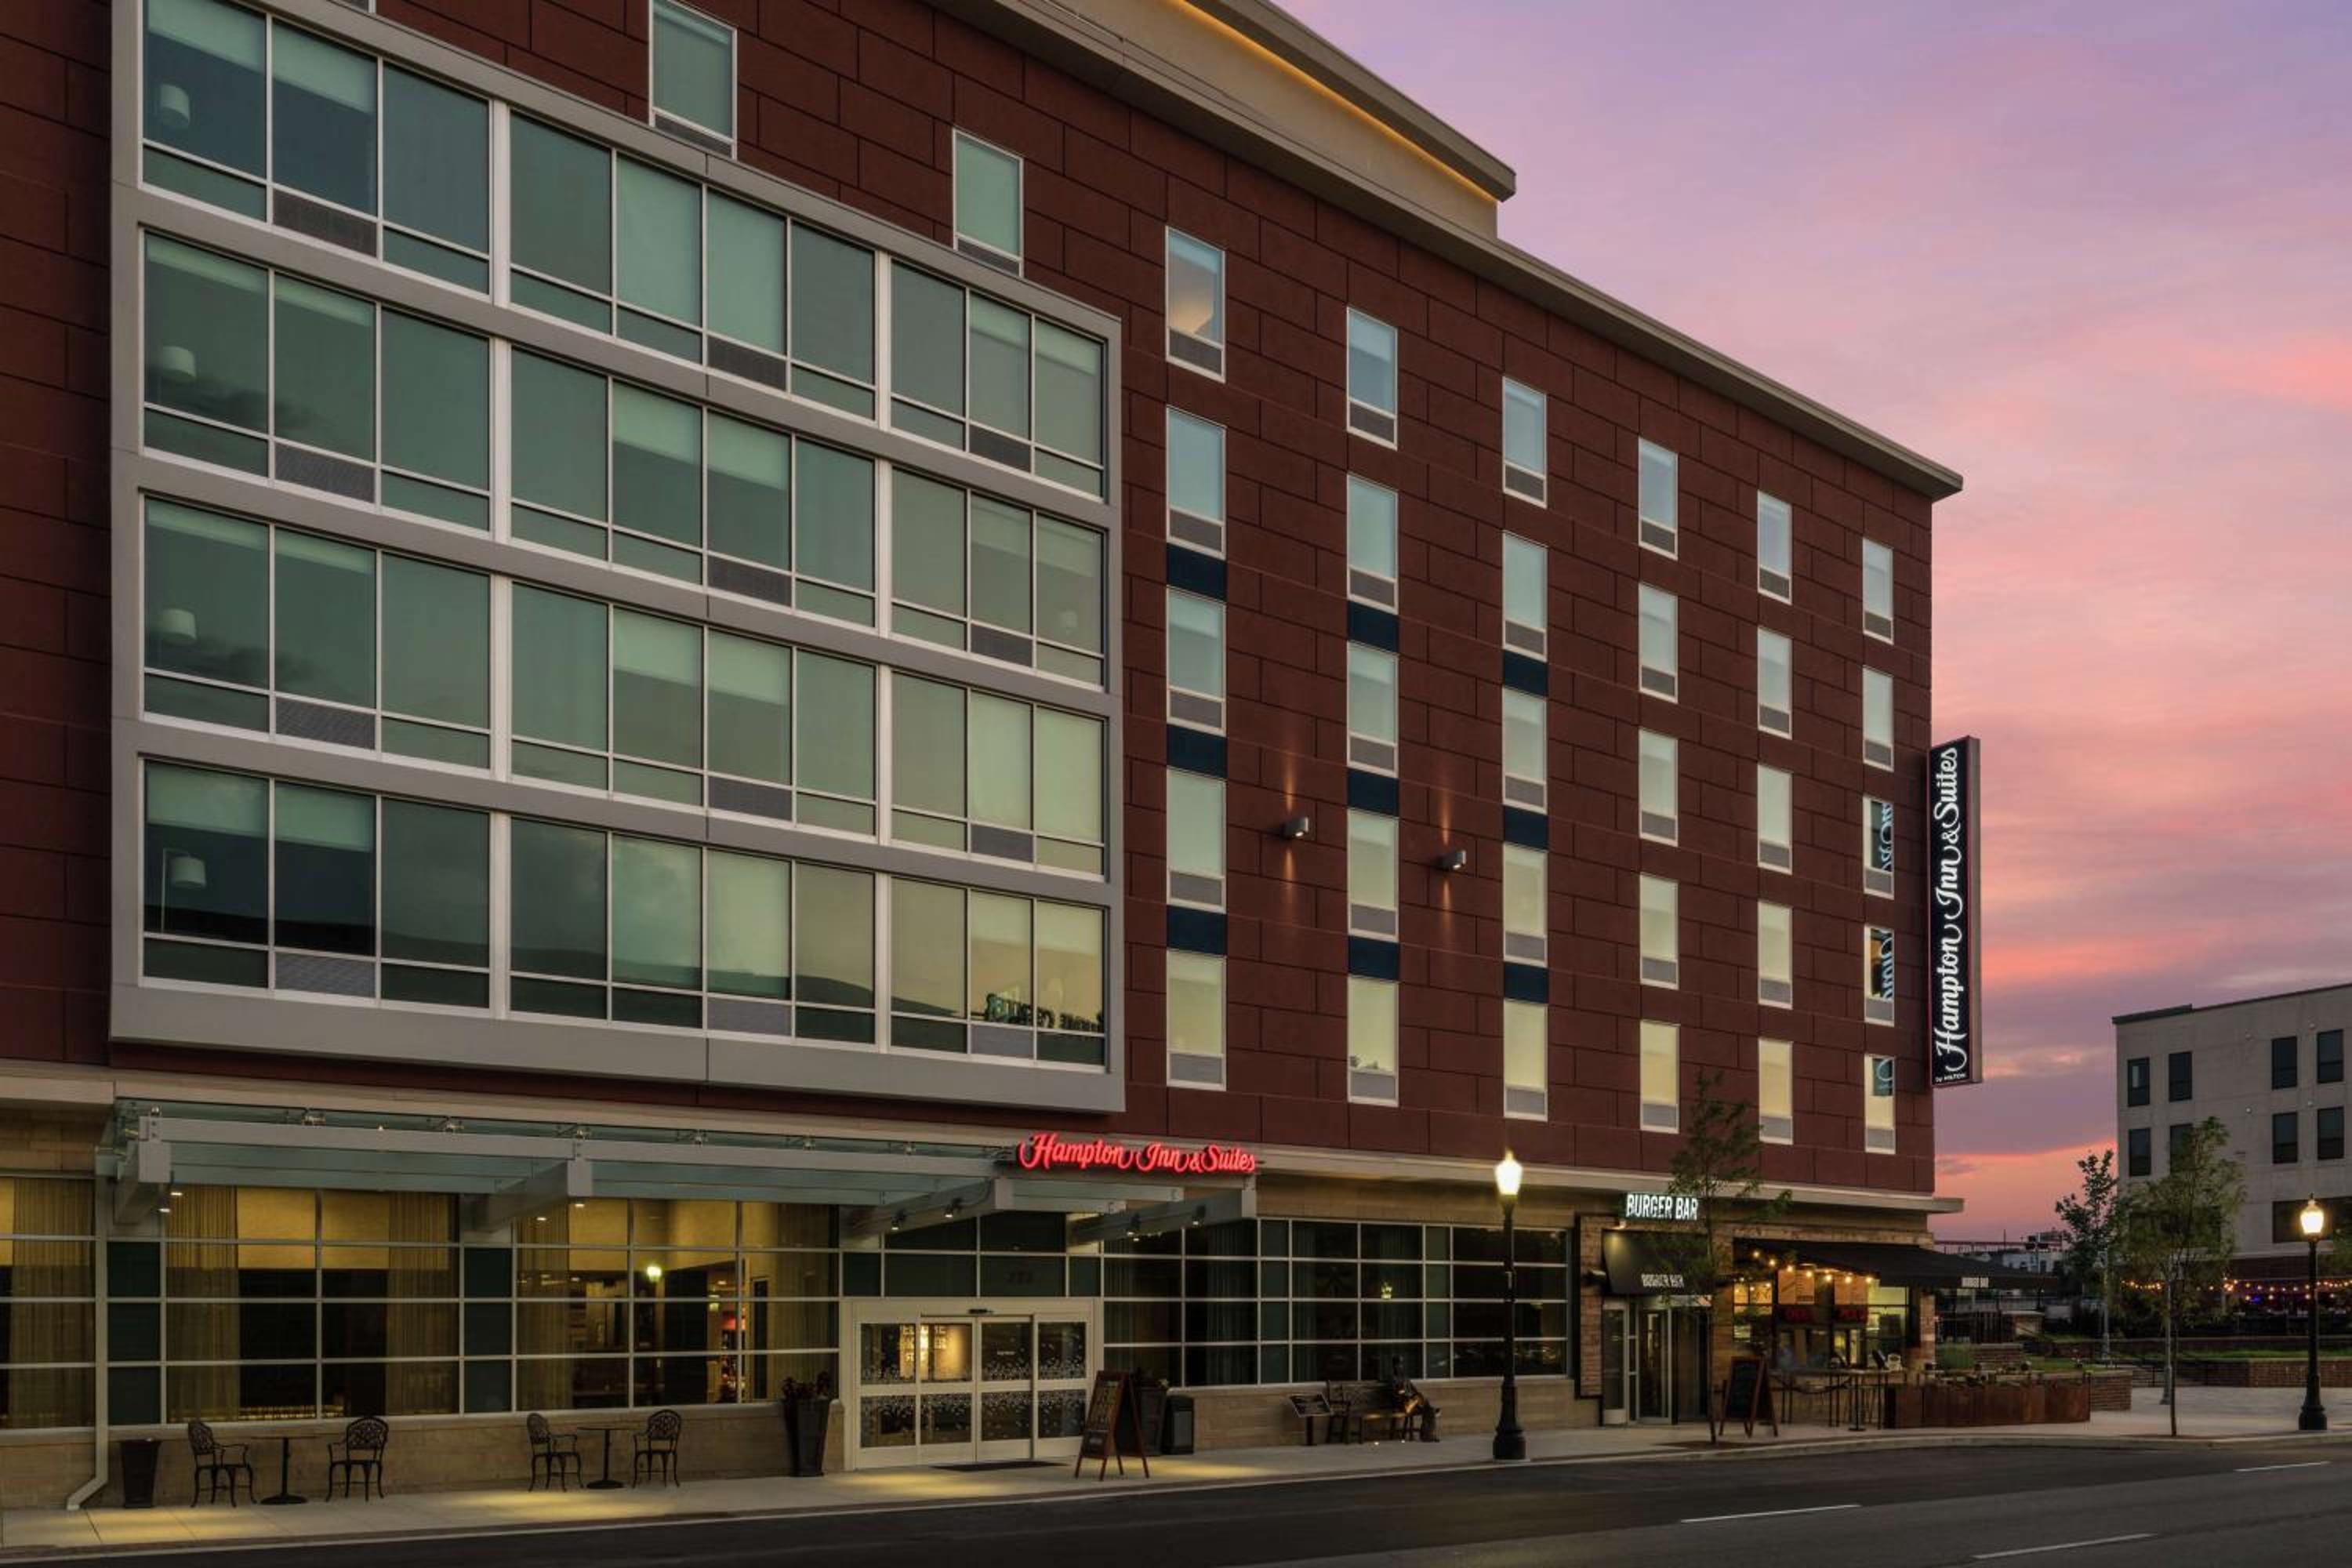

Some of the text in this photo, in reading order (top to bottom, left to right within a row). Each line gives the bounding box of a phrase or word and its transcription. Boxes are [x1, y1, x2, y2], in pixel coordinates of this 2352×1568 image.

[1933, 747, 1959, 828] Suites
[1935, 845, 1962, 920] Inn
[1933, 924, 1967, 1072] Hampton
[1019, 1132, 1133, 1170] Hampton
[1136, 1142, 1189, 1172] Inn
[1625, 1193, 1699, 1221] BURGER BAR
